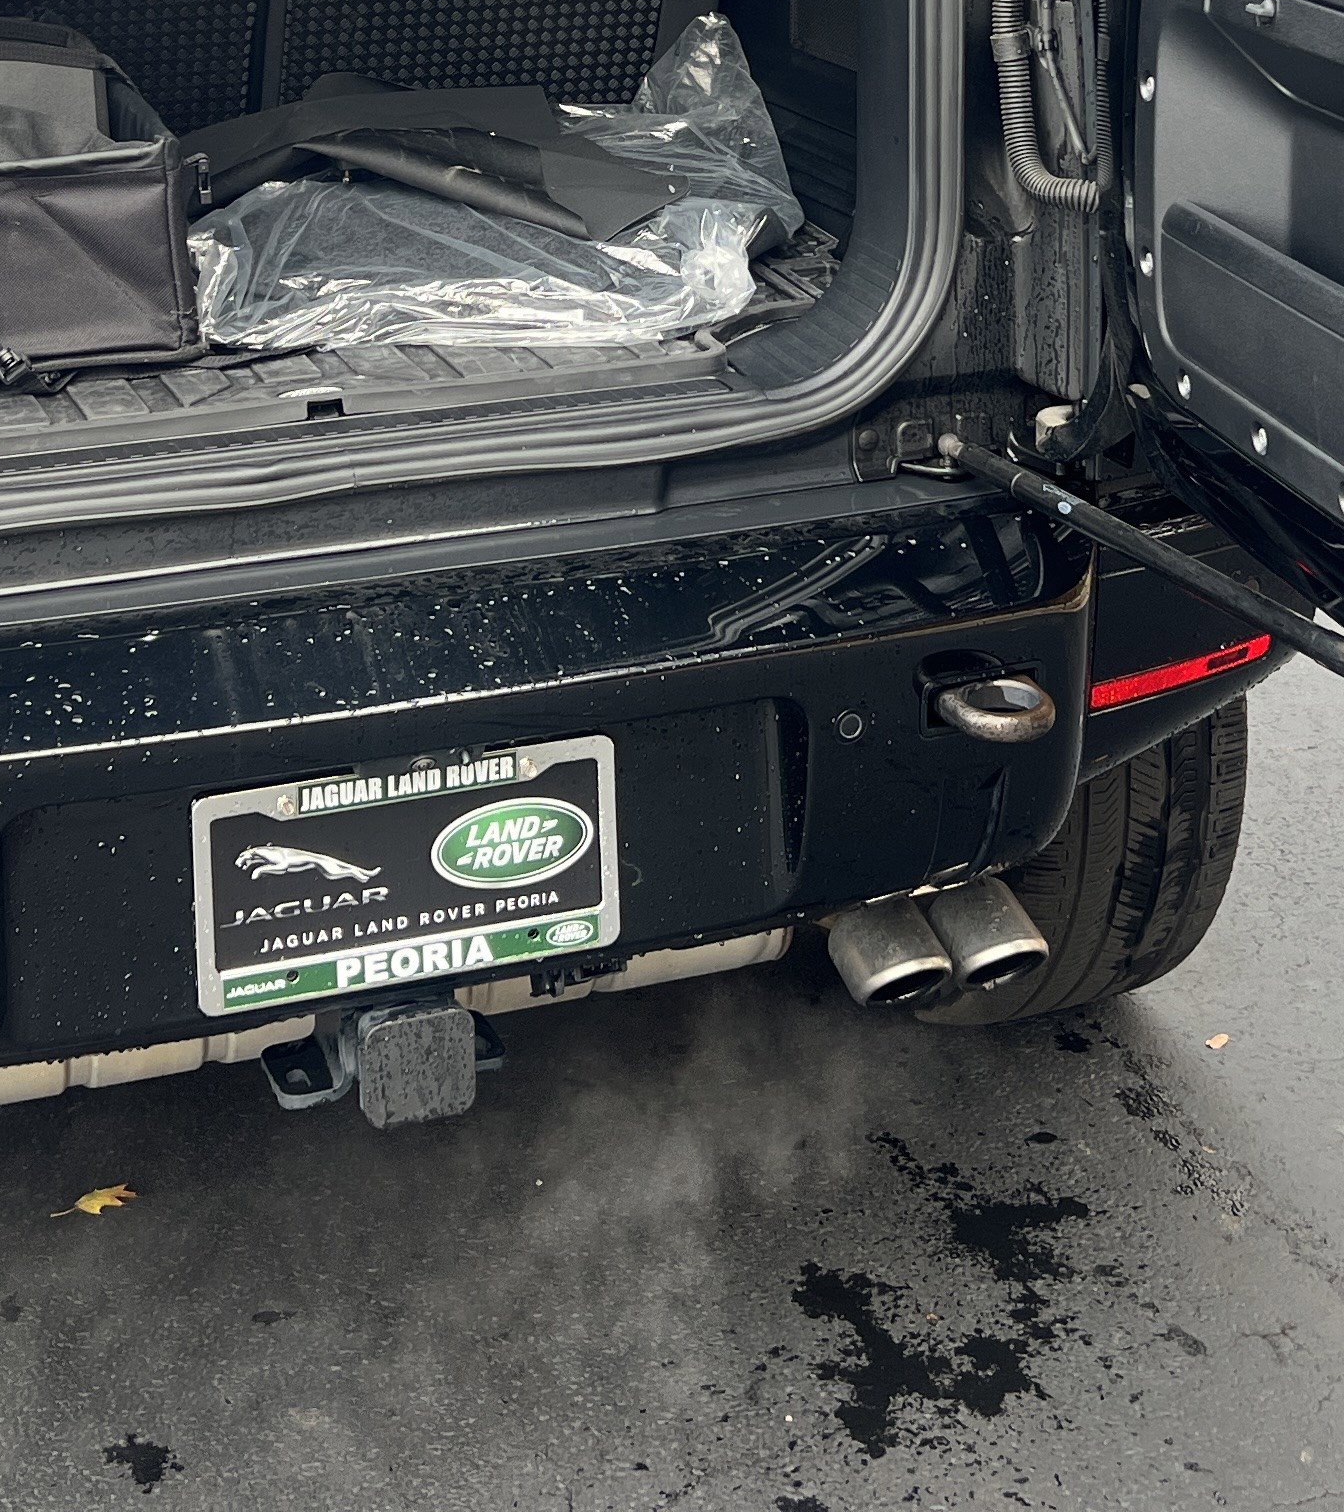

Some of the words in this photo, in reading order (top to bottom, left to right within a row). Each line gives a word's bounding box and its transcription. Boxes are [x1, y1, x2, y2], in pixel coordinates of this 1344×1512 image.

[300, 777, 383, 812] JAGUAR
[387, 768, 441, 798] LAND
[446, 756, 515, 788] ROVER
[466, 815, 541, 848] LAND
[472, 834, 564, 870] ROVER
[219, 887, 389, 929] JAGUAR
[260, 926, 344, 953] JAGUAR
[354, 916, 408, 937] LAND
[419, 902, 486, 926] ROVER
[495, 890, 559, 914] PEORIA
[336, 935, 494, 988] PEORIA
[226, 979, 287, 999] JAGUAR
